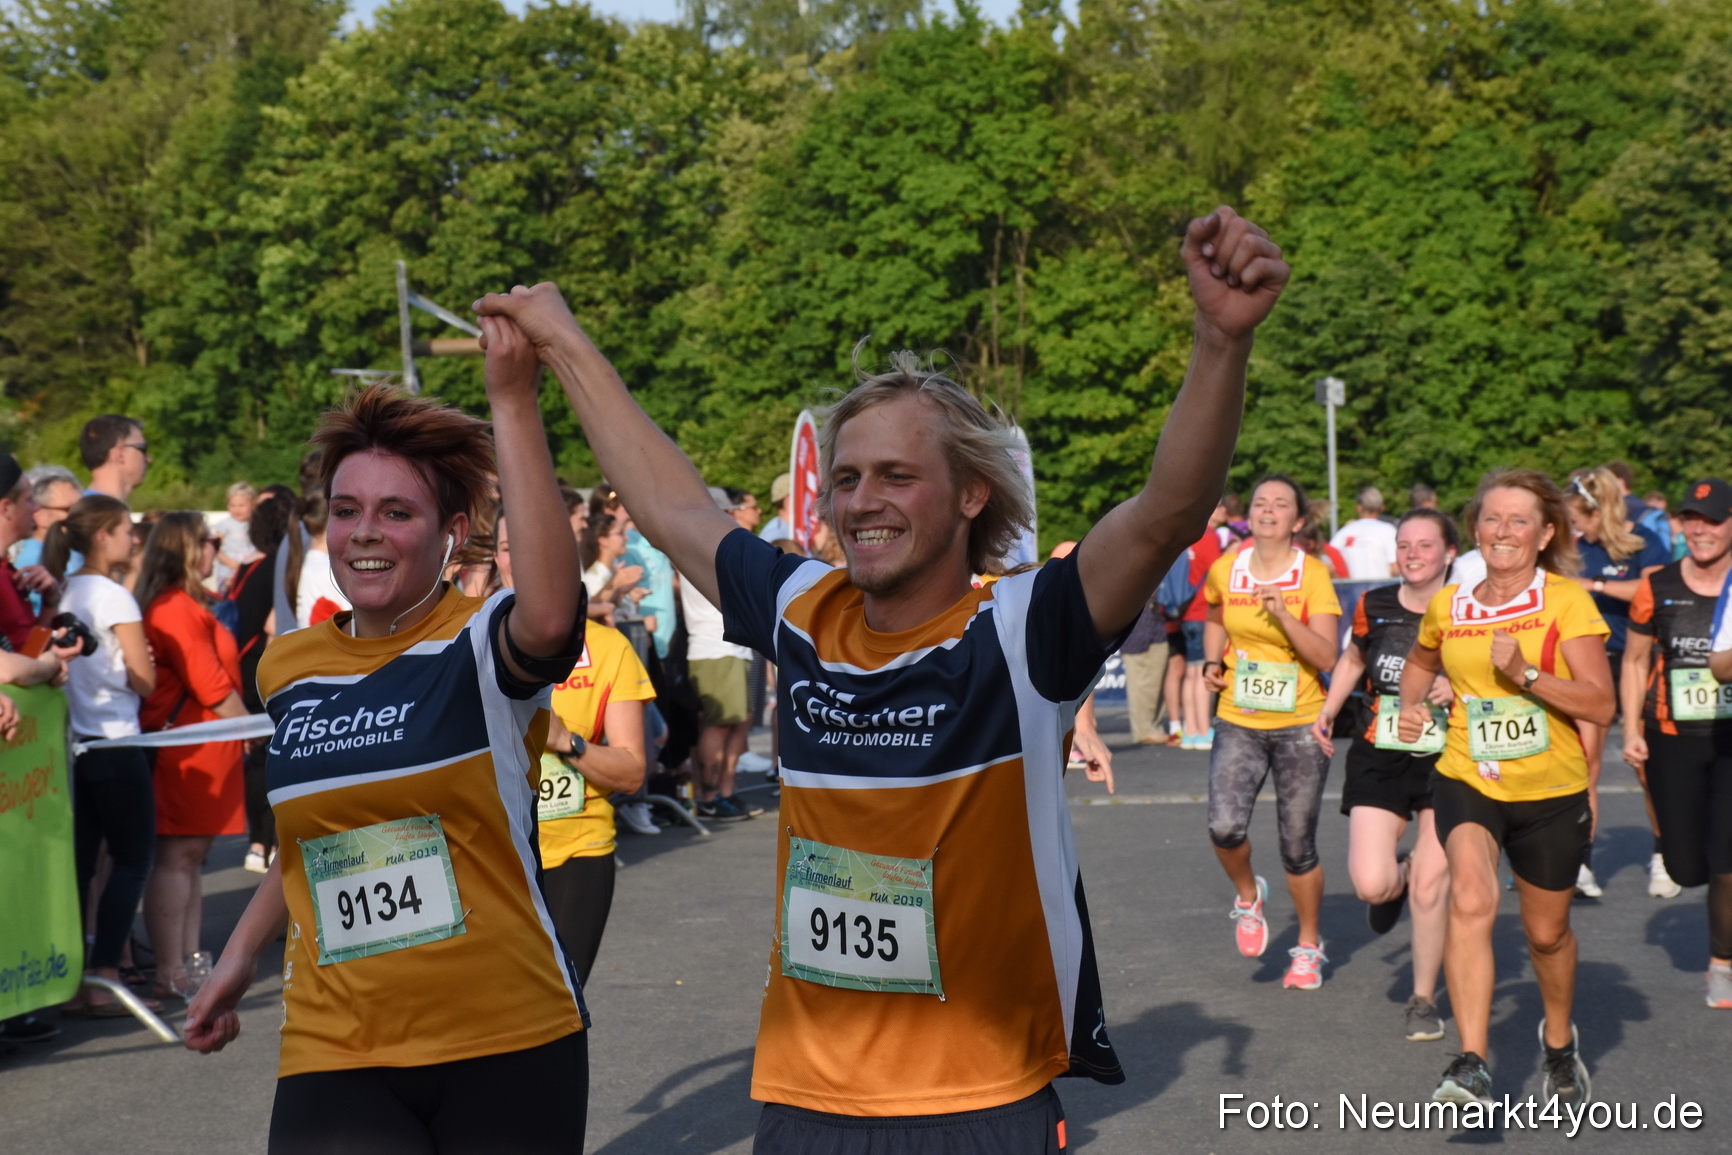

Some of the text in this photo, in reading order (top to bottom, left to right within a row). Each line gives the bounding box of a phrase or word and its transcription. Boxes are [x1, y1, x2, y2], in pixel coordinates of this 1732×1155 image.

[1228, 597, 1258, 606] MAX
[1447, 628, 1488, 640] MAX
[1242, 677, 1288, 697] 1587
[1684, 686, 1732, 705] 1019
[282, 701, 415, 746] Fischer
[1387, 715, 1436, 736] 12
[1477, 716, 1537, 743] 1704
[290, 728, 404, 760] AUTOMOBILE
[818, 731, 933, 747] AUTOMOBILE
[324, 851, 365, 872] firmenlauf
[409, 845, 438, 861] 2019
[806, 867, 852, 889] firmenlauf
[893, 894, 923, 907] 2019
[337, 875, 423, 930] 9134
[810, 907, 899, 962] 9135
